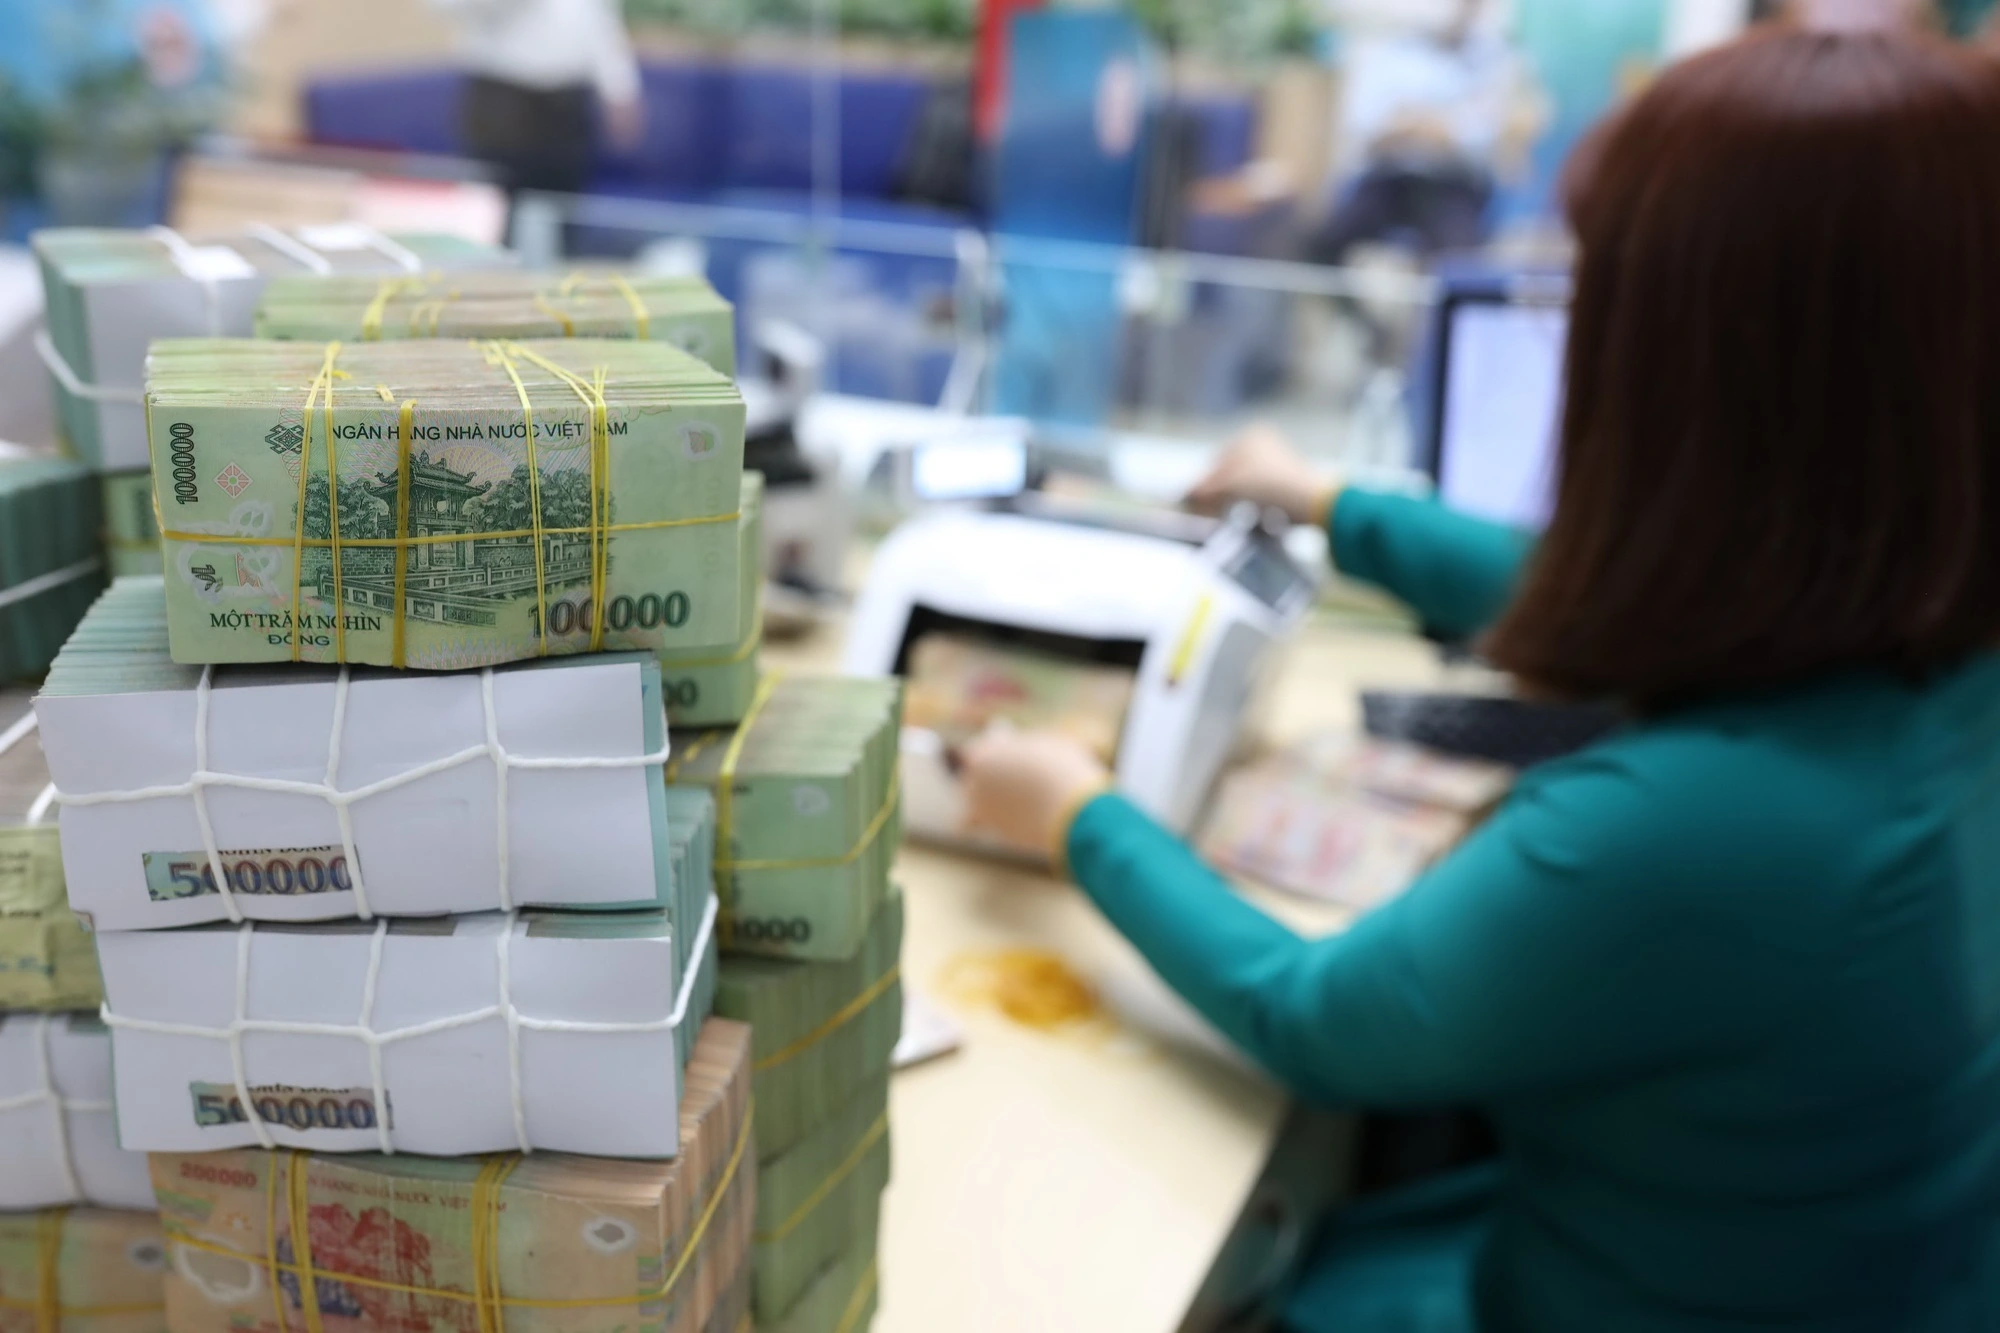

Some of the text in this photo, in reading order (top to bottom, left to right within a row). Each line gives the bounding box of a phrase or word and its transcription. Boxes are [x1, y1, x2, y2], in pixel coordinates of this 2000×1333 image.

[387, 425, 441, 441] HNG
[446, 422, 484, 440] NHÀ
[488, 421, 540, 439] NƯỚC
[545, 420, 584, 440] VIỆT
[169, 422, 198, 505] 100.000
[210, 608, 254, 631] MỘT
[254, 610, 313, 629] TRĂM
